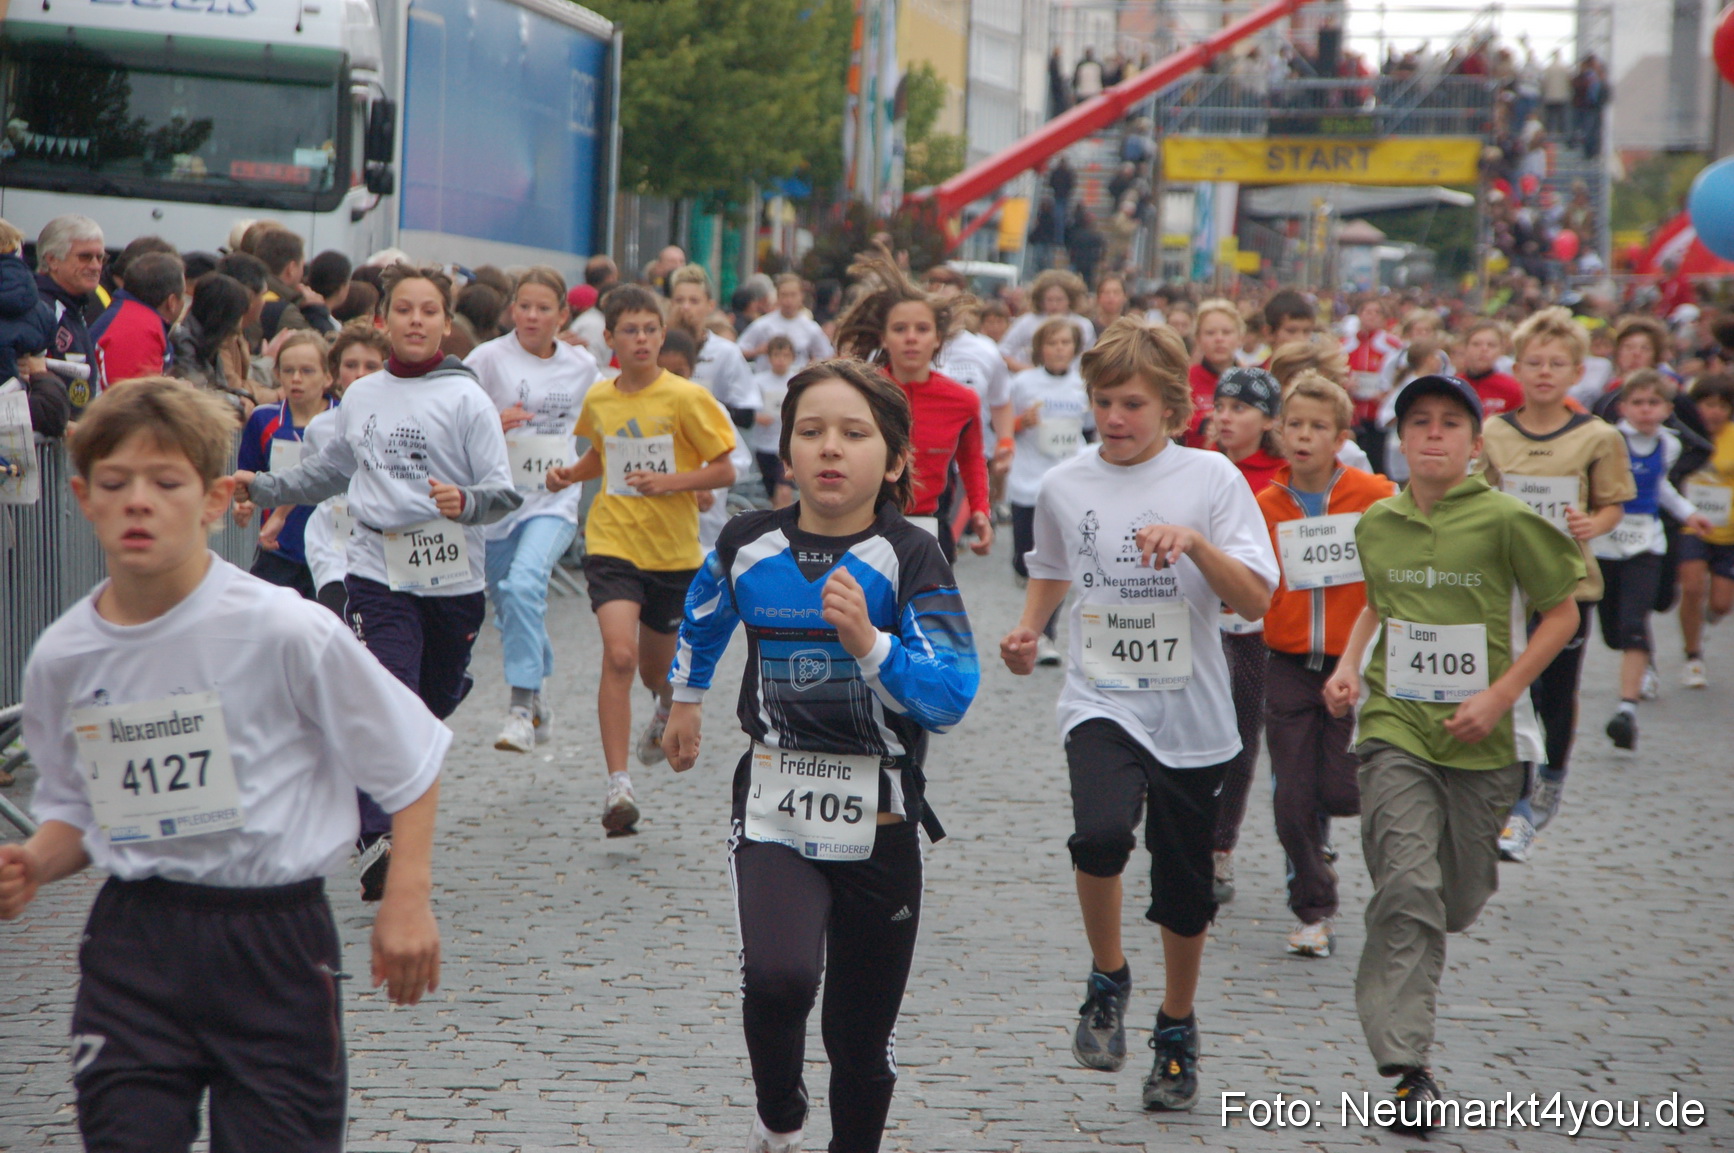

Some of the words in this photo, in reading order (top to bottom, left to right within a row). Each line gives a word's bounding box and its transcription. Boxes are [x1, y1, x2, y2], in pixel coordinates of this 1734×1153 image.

[1266, 146, 1370, 172] START
[1527, 501, 1571, 518] 117
[404, 530, 444, 547] Tina
[1300, 524, 1337, 539] Florian
[408, 544, 459, 567] 4149
[1303, 541, 1357, 565] 4095
[1083, 572, 1100, 588] 9.
[1103, 575, 1178, 587] Neumarkter
[1389, 568, 1426, 584] EURO
[1438, 571, 1482, 587] POLES
[1120, 586, 1178, 599] Stadtlauf
[1107, 612, 1156, 630] Manuel
[1409, 624, 1438, 642] Leon
[1111, 637, 1179, 663] 4017
[1410, 651, 1477, 676] 4108
[110, 709, 204, 743] Alexander
[122, 749, 212, 796] 4127
[780, 752, 852, 780] Frédéric
[778, 788, 863, 824] 4105
[177, 807, 239, 827] PFLEIDERER
[819, 842, 870, 854] PFLEIDERER
